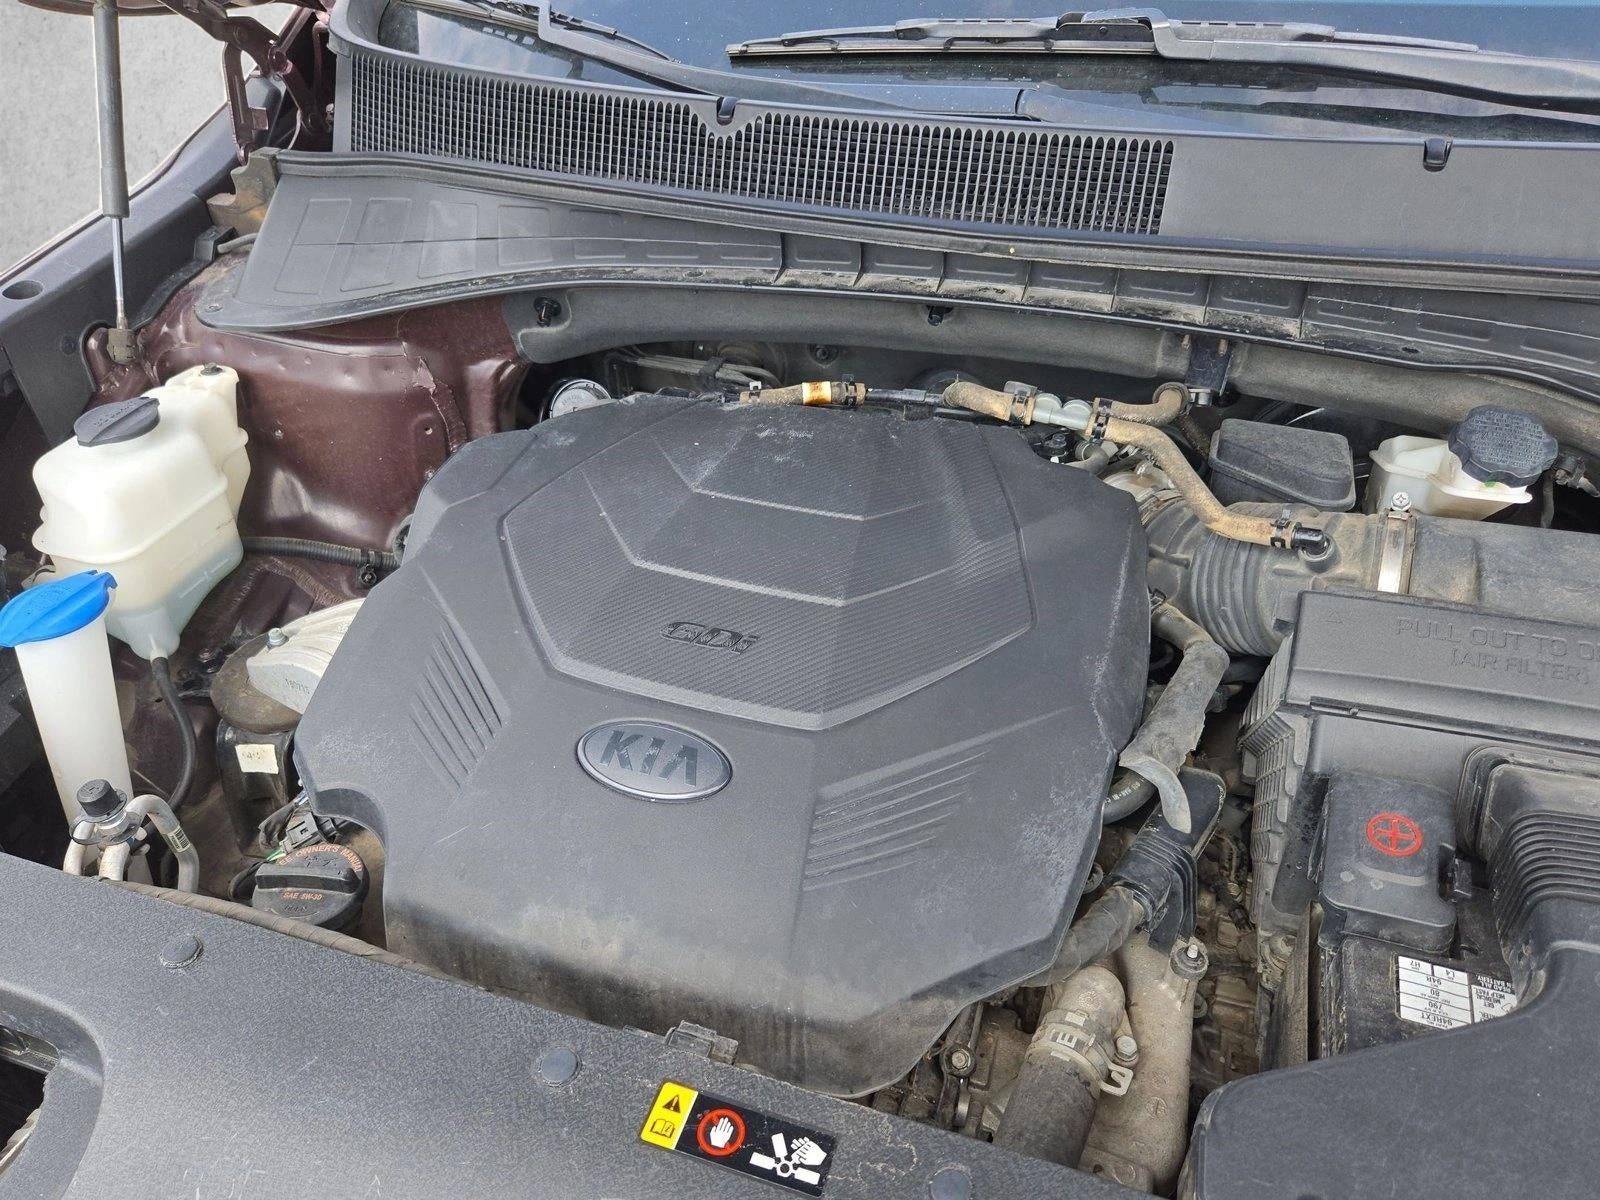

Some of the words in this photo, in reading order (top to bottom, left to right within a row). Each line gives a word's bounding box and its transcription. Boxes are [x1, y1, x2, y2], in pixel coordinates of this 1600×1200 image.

[1397, 616, 1462, 643] PULL
[1470, 626, 1525, 651] OUT
[1532, 633, 1568, 657] TO
[601, 730, 698, 787] KIA
[282, 891, 299, 900] SAE
